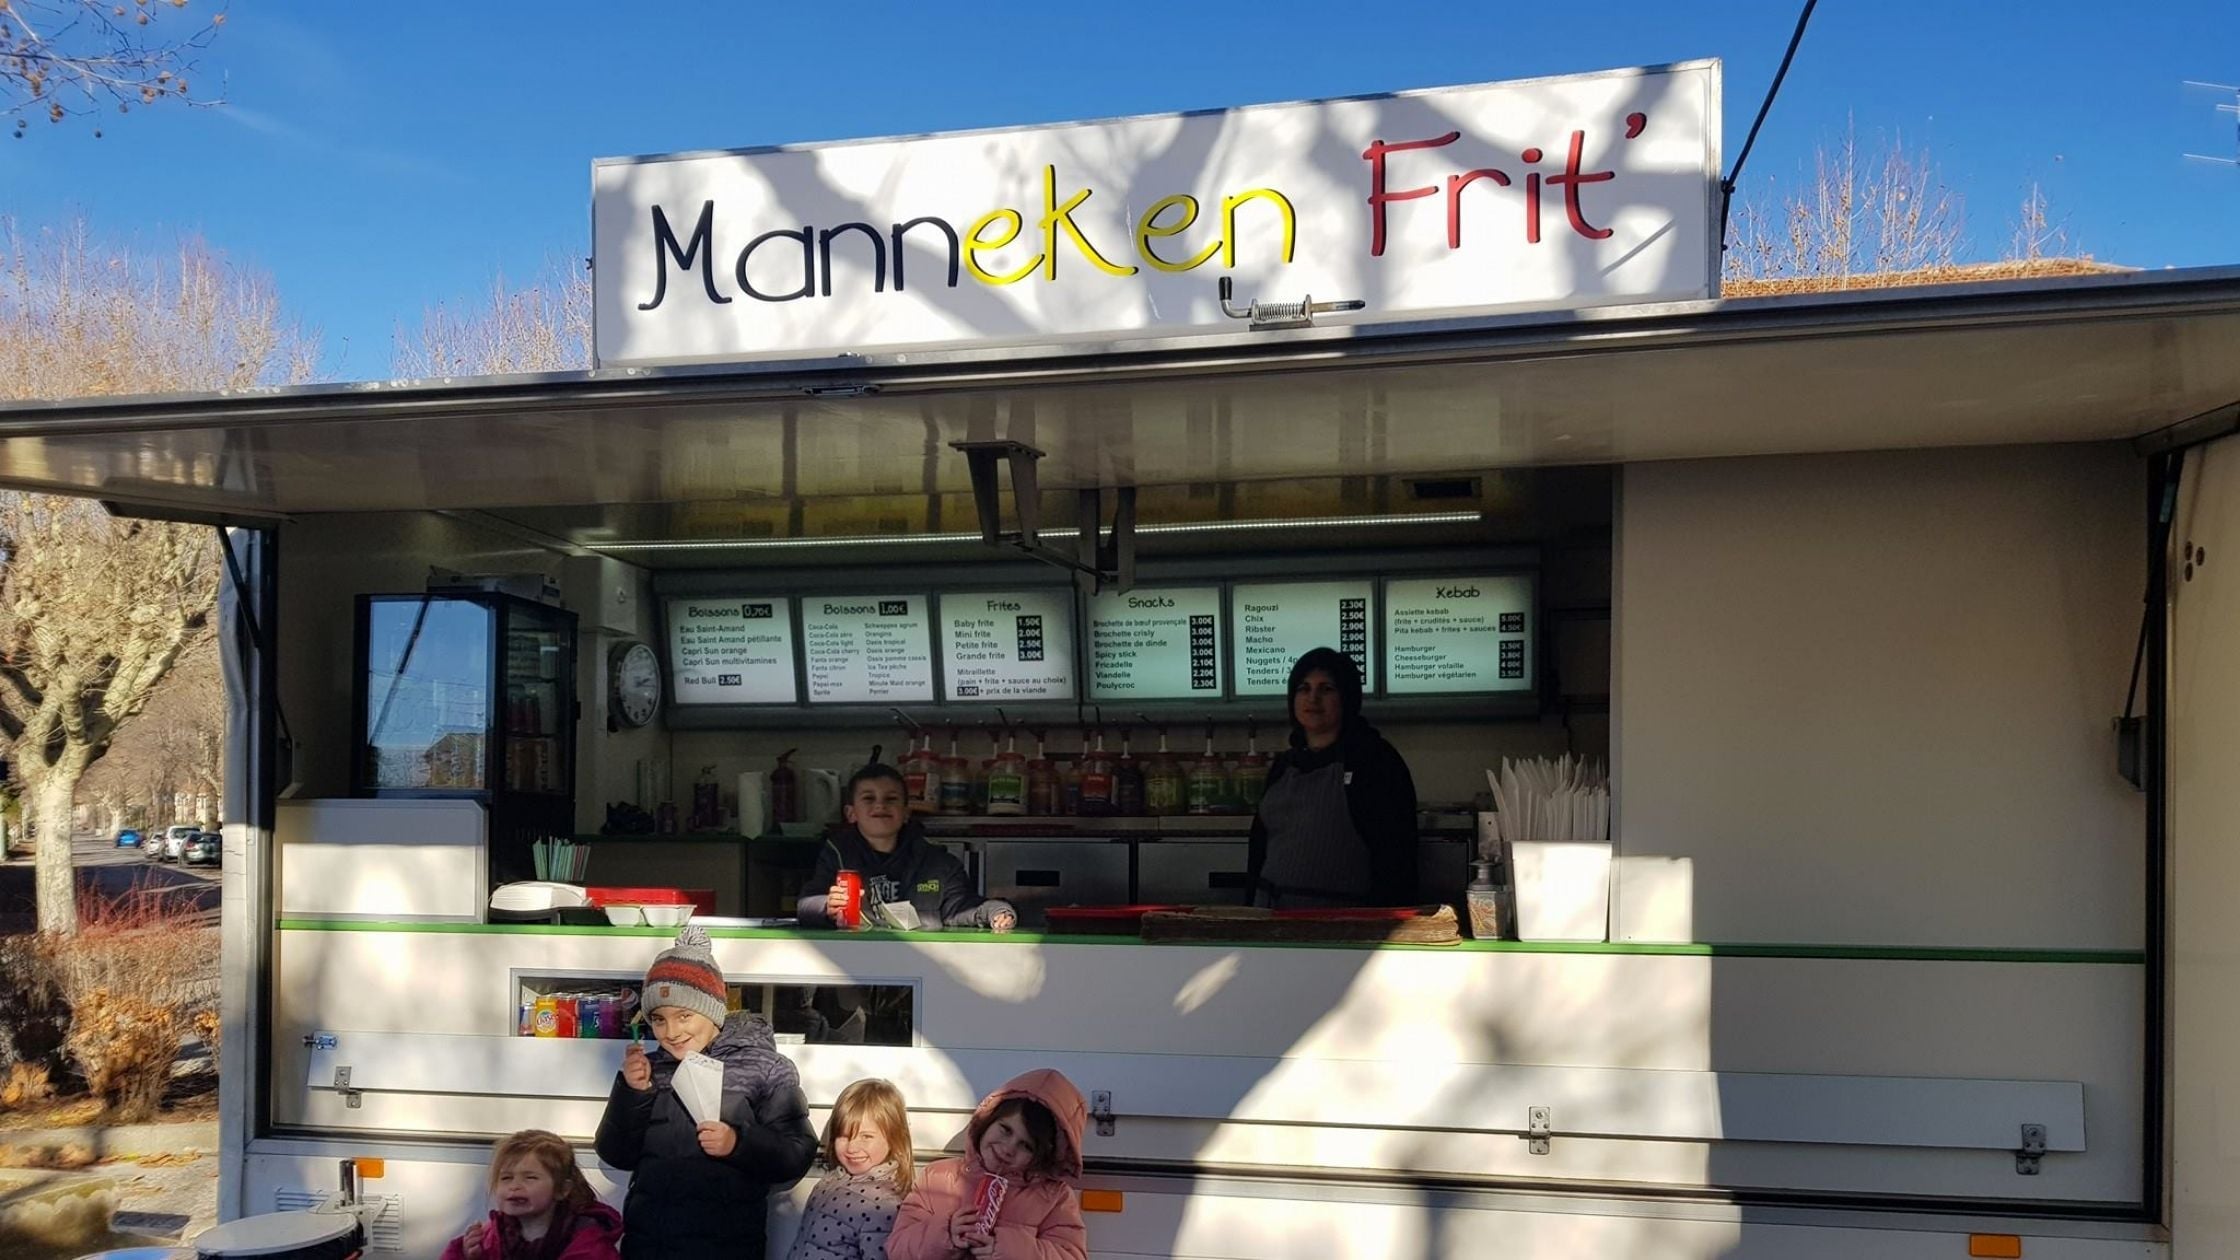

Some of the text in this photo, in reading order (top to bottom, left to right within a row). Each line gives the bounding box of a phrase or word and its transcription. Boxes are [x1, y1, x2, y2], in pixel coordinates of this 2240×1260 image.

[638, 112, 1647, 310] Manneken Frit'
[1436, 585, 1480, 599] Kebab
[986, 600, 1022, 612] Frites
[1128, 596, 1175, 609] Snacks
[688, 606, 740, 618] Boissons
[823, 603, 876, 615] Boissons
[1244, 604, 1279, 613] Ragouzi
[1245, 611, 1364, 623] Chix 2.50€
[954, 619, 976, 629] Baby
[977, 618, 994, 628] frite
[680, 625, 694, 633] Eau
[954, 629, 972, 638] Mini
[974, 629, 991, 638] frite
[1245, 625, 1276, 633] Ribster
[1441, 625, 1461, 633] frites
[1094, 630, 1132, 638] Brochette
[681, 636, 695, 644] Eau
[955, 640, 980, 649] Petite
[981, 639, 998, 649] frite
[1094, 640, 1132, 648] Brochette
[1145, 639, 1168, 647] dinde
[682, 647, 748, 656] Capri Sun orange
[1246, 646, 1286, 654] Mexicano
[1394, 645, 1436, 653] Hamburger
[956, 651, 987, 660] Grande
[988, 650, 1006, 660] frite
[1095, 651, 1116, 660] Spicy
[1118, 650, 1137, 658] stick
[1394, 654, 1447, 662] Cheeseburger
[682, 656, 778, 666] Capri Sun multivitamines
[1095, 661, 1133, 669] Fricadelle
[1246, 656, 1281, 666] Nuggets
[1247, 667, 1280, 675] Tenders
[1394, 663, 1436, 671] Hamburger
[1095, 671, 1131, 679] Viandelle
[1394, 672, 1436, 680] Hamburger
[684, 676, 700, 684] Red
[701, 676, 717, 684] Bull
[985, 677, 1000, 685] frite
[1248, 677, 1280, 686] Tenders
[1096, 681, 1135, 691] Poulycroc
[986, 687, 1001, 696] prix
[1002, 686, 1012, 694] de
[1013, 686, 1021, 694] la
[1022, 686, 1047, 694] viande
